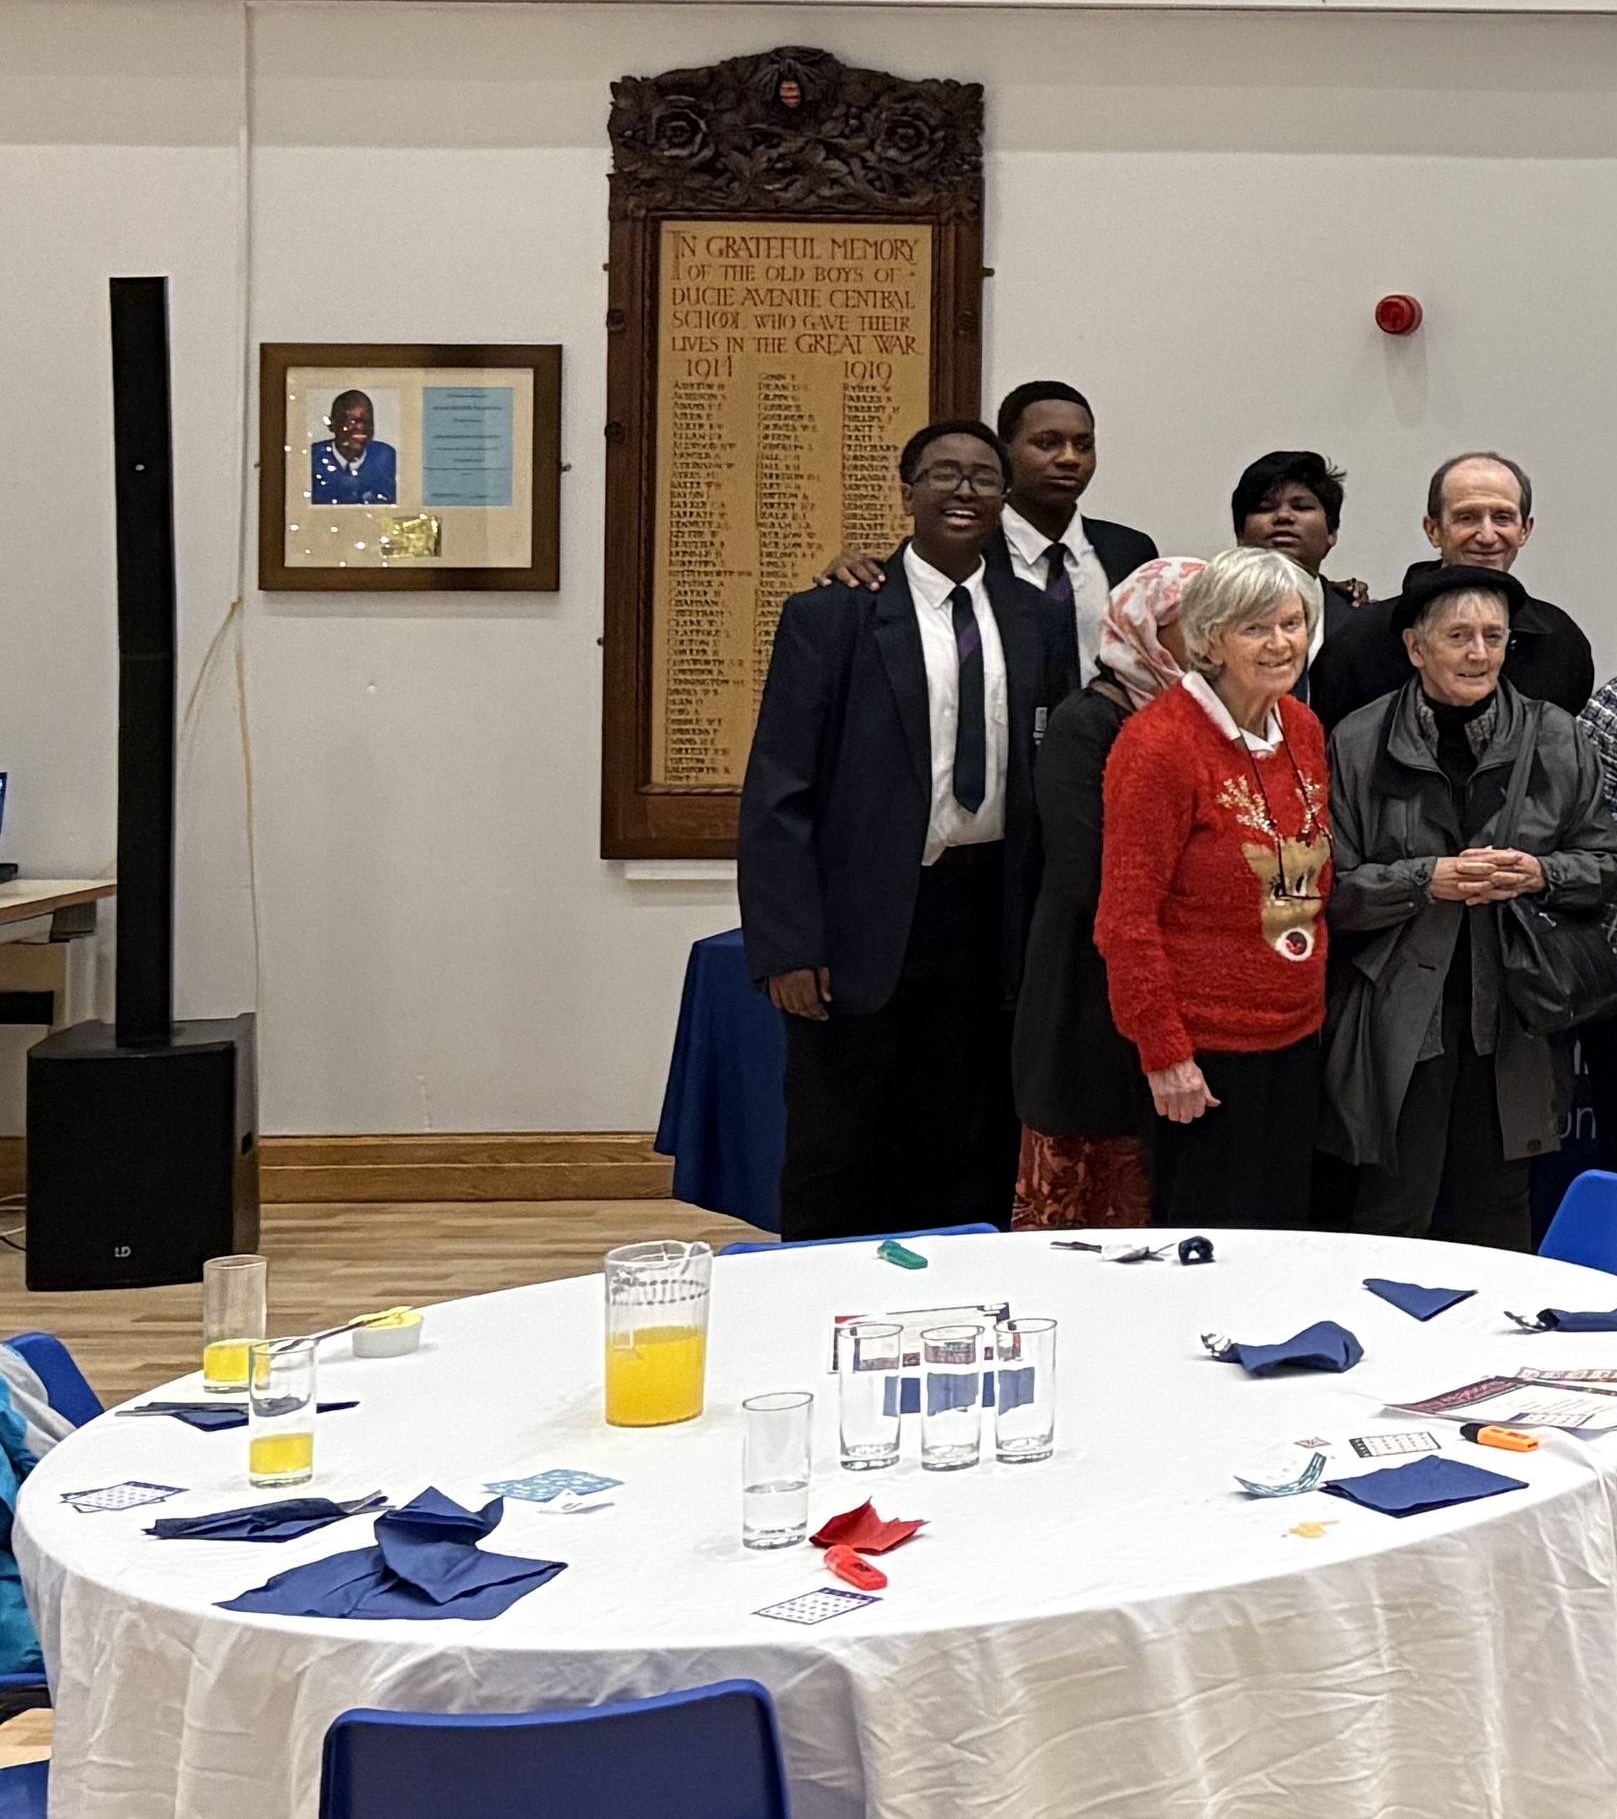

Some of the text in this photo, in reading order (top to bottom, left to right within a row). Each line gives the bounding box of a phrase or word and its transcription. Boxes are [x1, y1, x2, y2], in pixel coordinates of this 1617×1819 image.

[706, 237, 822, 262] GRATEFUL
[831, 238, 920, 264] MEMORY
[688, 264, 902, 284] OF THE OLD BOYS OF
[672, 288, 916, 311] DUCIE AVENUE CENTRAL
[673, 311, 911, 333] SCHOOL WHO GAVE THEIR
[672, 334, 918, 356] LIVES IN THE GREAT WAR
[844, 360, 893, 385] 1919
[115, 1246, 131, 1257] LD
